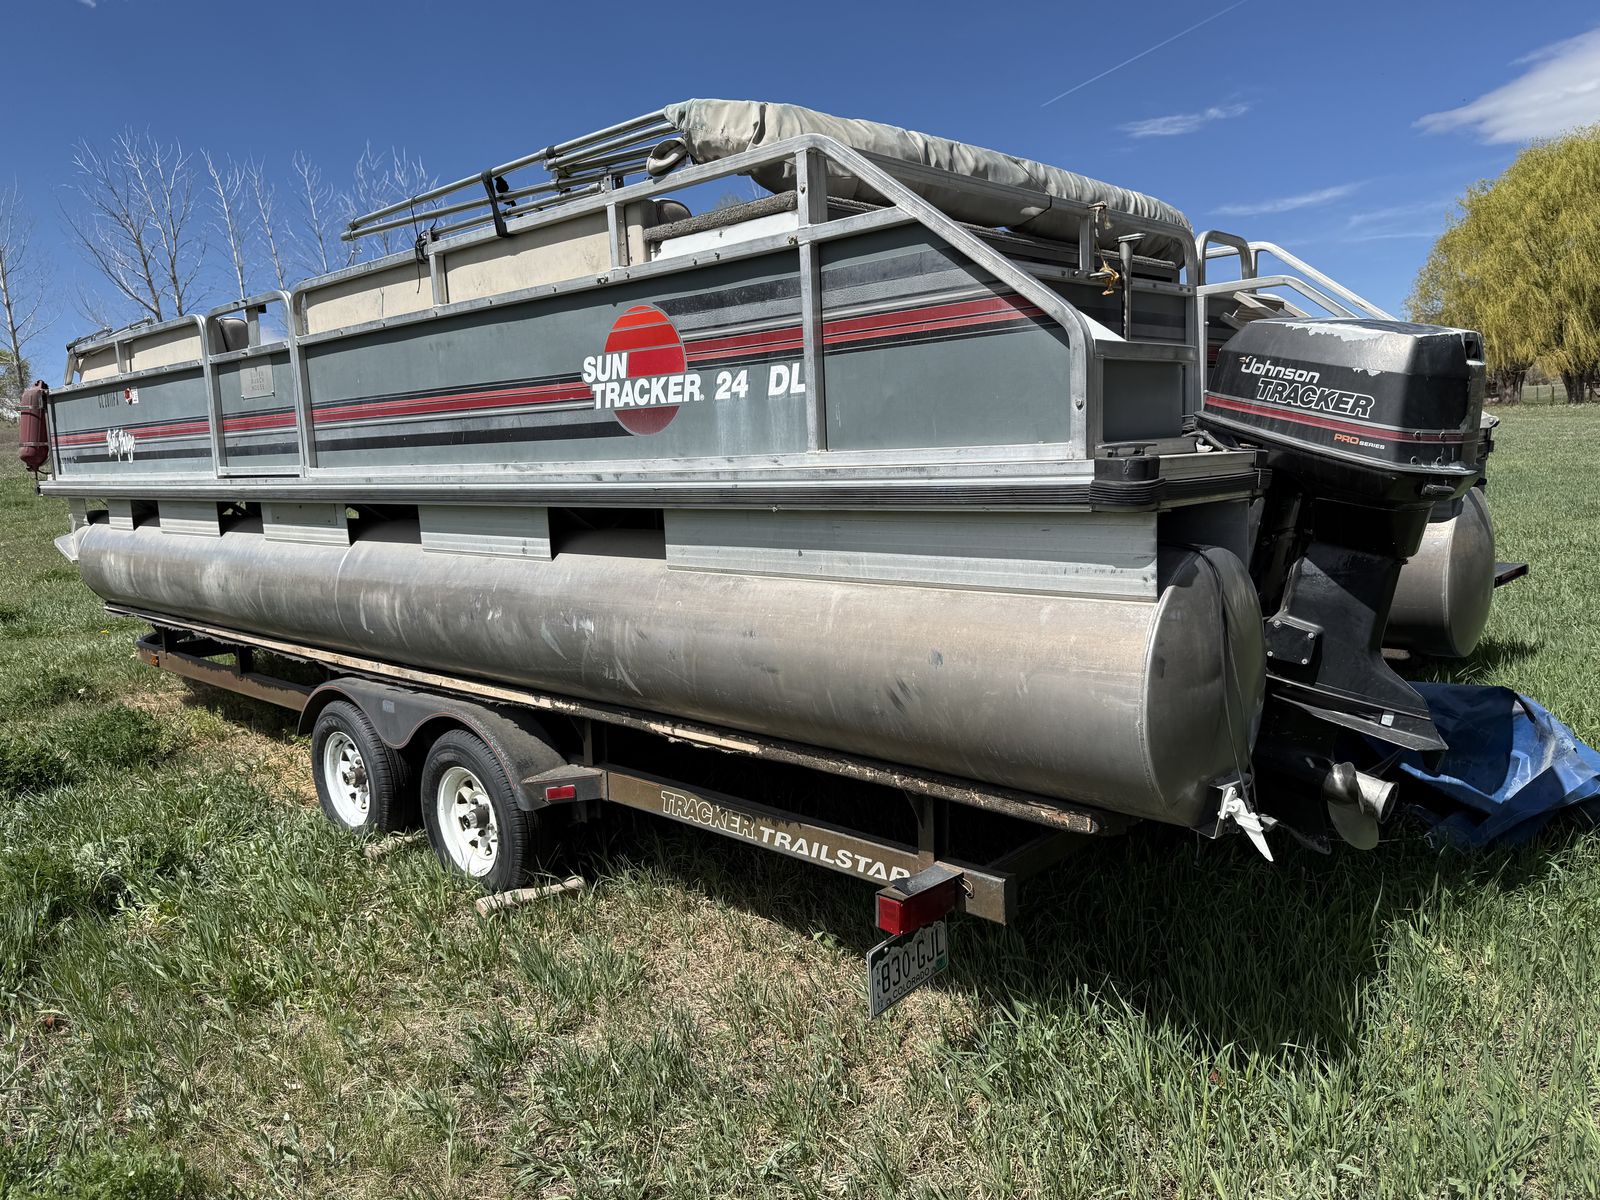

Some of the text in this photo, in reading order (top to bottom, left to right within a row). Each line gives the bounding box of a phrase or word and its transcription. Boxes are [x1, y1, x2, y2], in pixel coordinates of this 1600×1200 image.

[583, 352, 628, 383] SUN
[1240, 356, 1320, 383] Johnson
[591, 373, 702, 409] TRACKER
[714, 369, 749, 400] 24
[1257, 378, 1375, 419] TRACKER
[1333, 433, 1386, 450] PRO SERIES
[660, 790, 754, 839] TRACKER
[881, 927, 945, 994] 830-GJL
[892, 967, 930, 999] COLORADO
